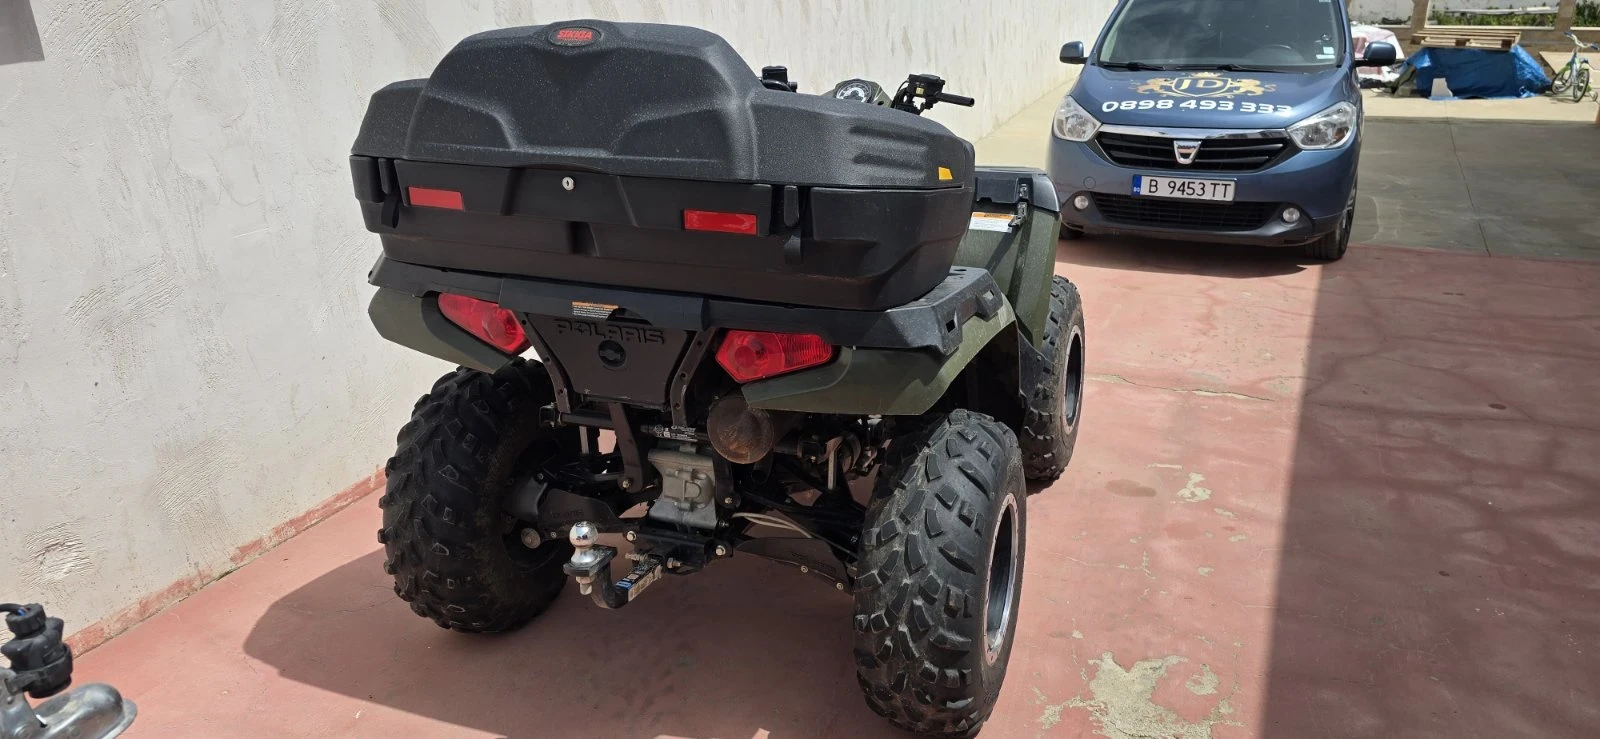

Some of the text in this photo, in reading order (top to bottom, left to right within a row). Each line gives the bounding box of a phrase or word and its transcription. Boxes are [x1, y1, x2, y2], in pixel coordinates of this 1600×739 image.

[1101, 99, 1294, 117] 0898 493 333
[1148, 179, 1159, 194] B
[1167, 180, 1206, 196] 9453
[1210, 182, 1231, 198] TT
[553, 319, 665, 344] POLARIS
